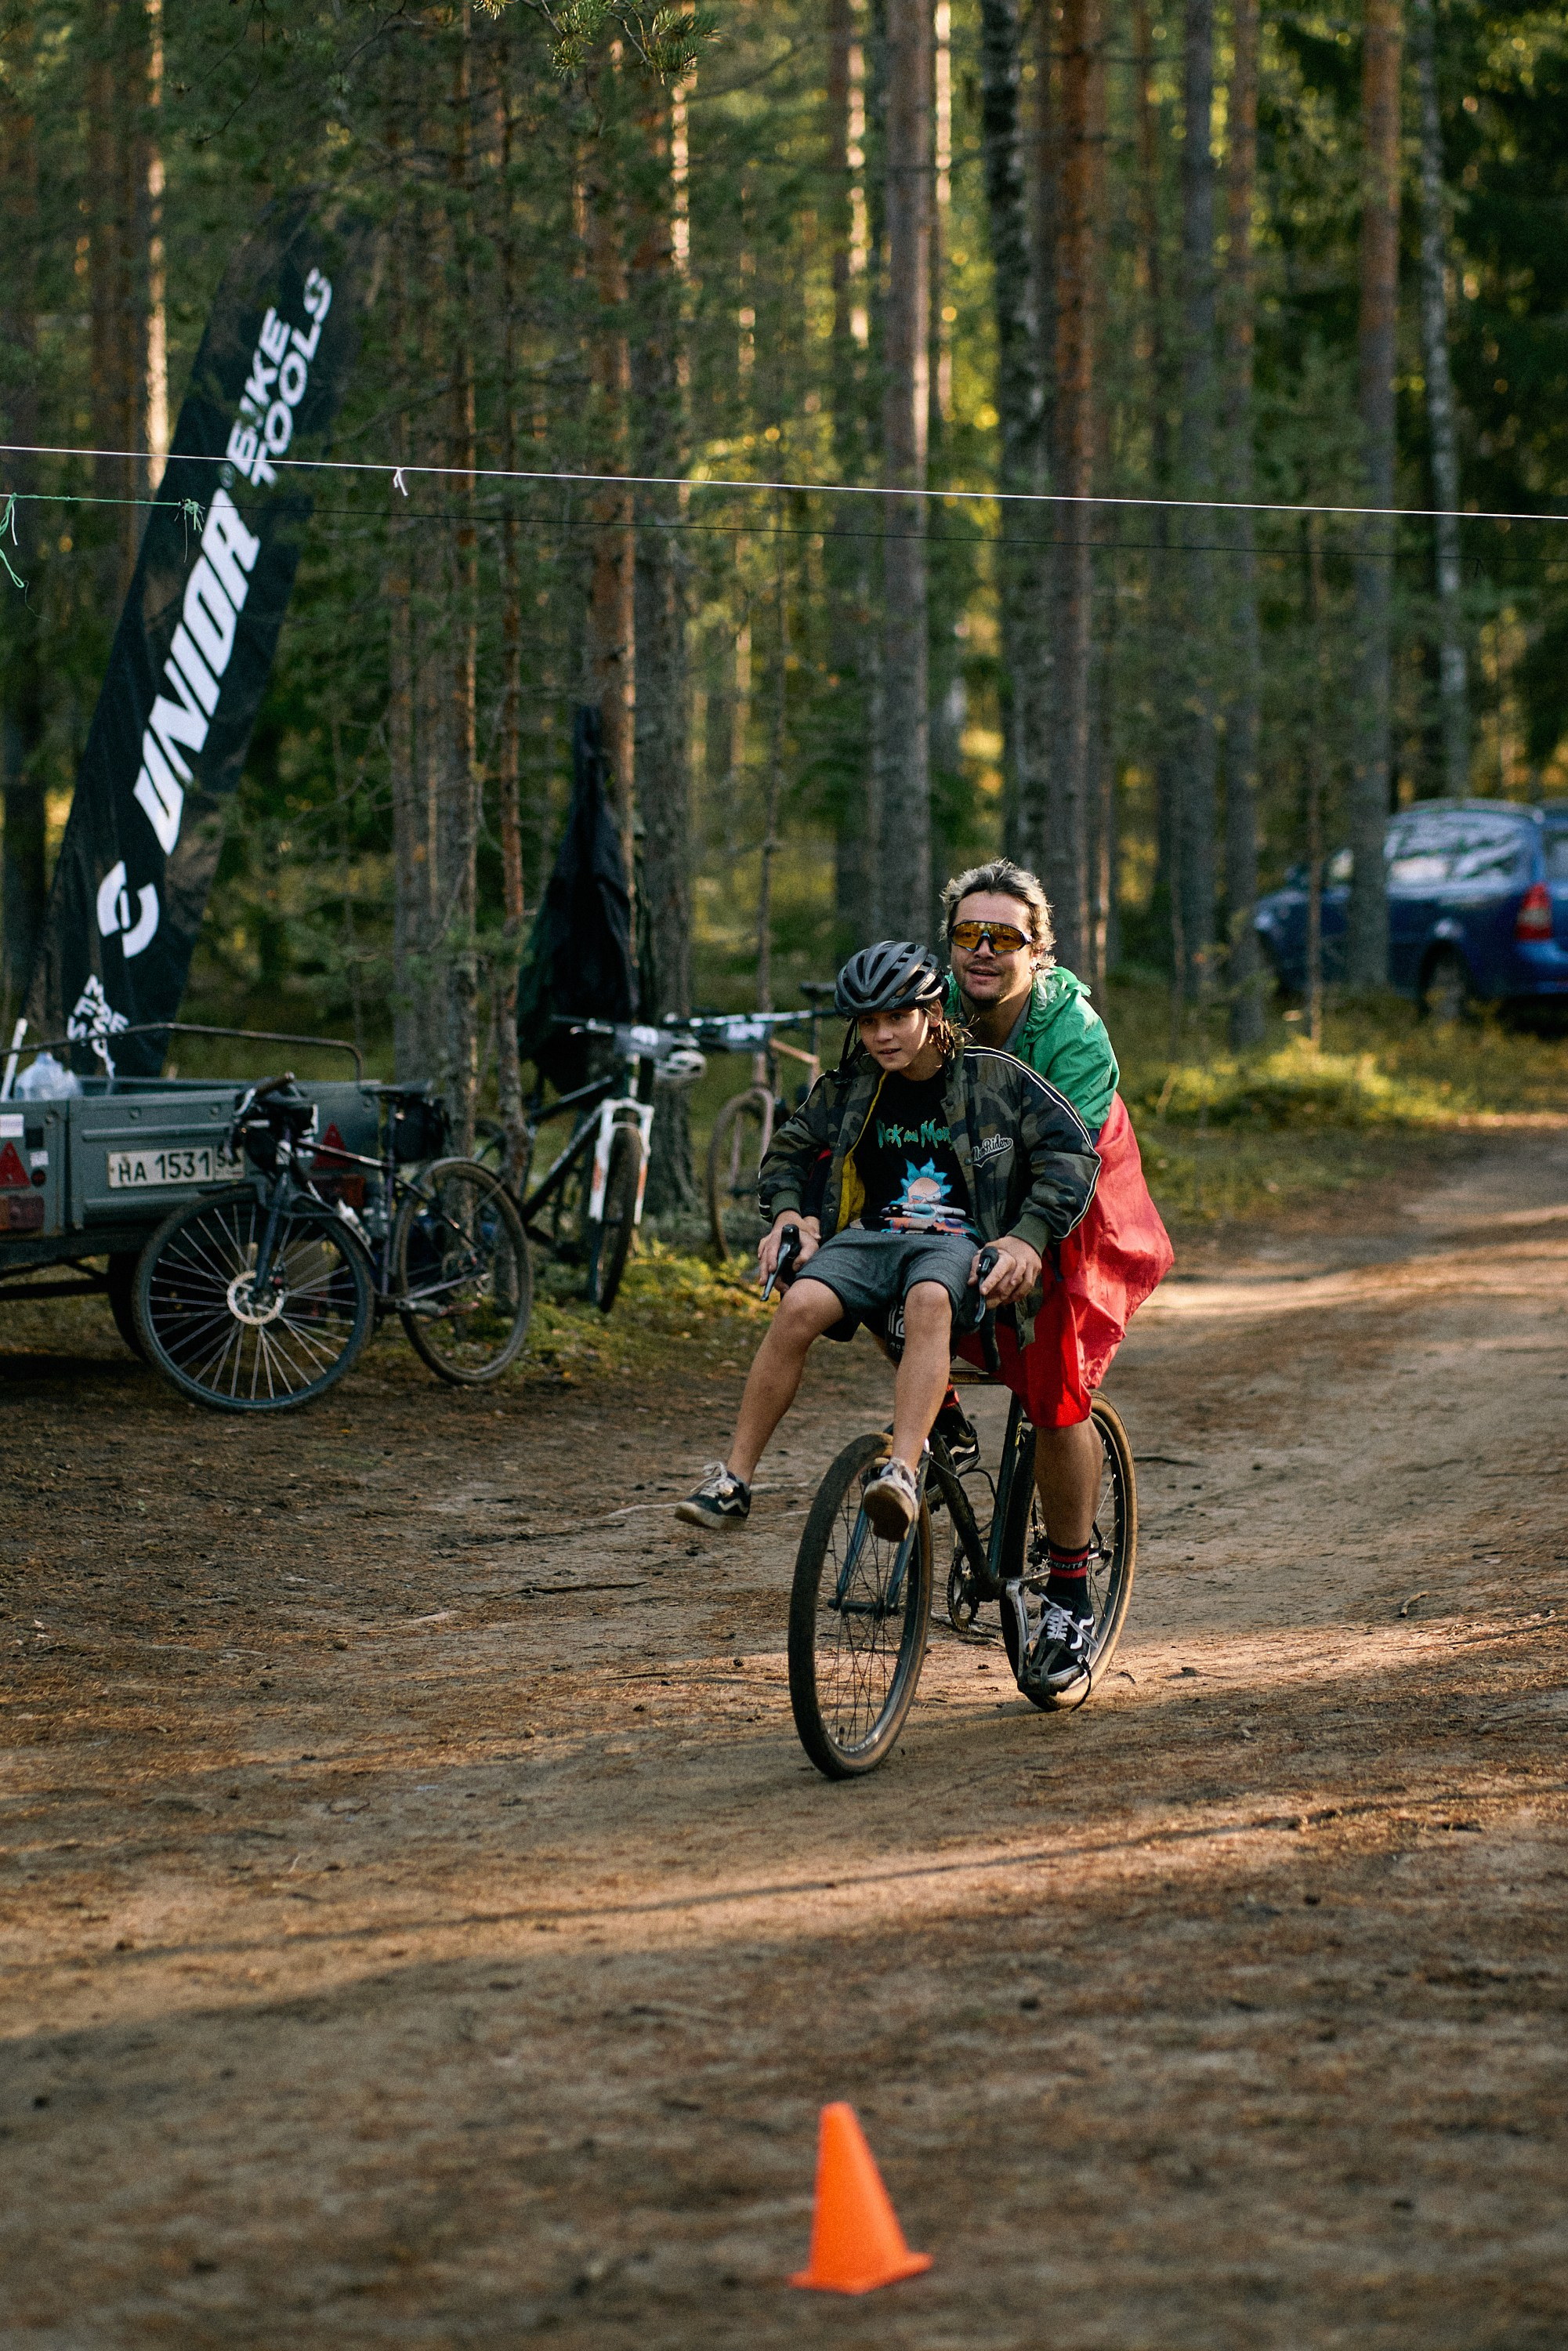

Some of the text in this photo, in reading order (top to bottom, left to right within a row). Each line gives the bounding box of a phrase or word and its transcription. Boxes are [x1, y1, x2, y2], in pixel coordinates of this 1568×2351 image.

[226, 306, 292, 476] BIKE
[250, 267, 332, 487] TOOLS
[133, 487, 261, 856] UNIOR
[155, 1151, 210, 1179] 1531
